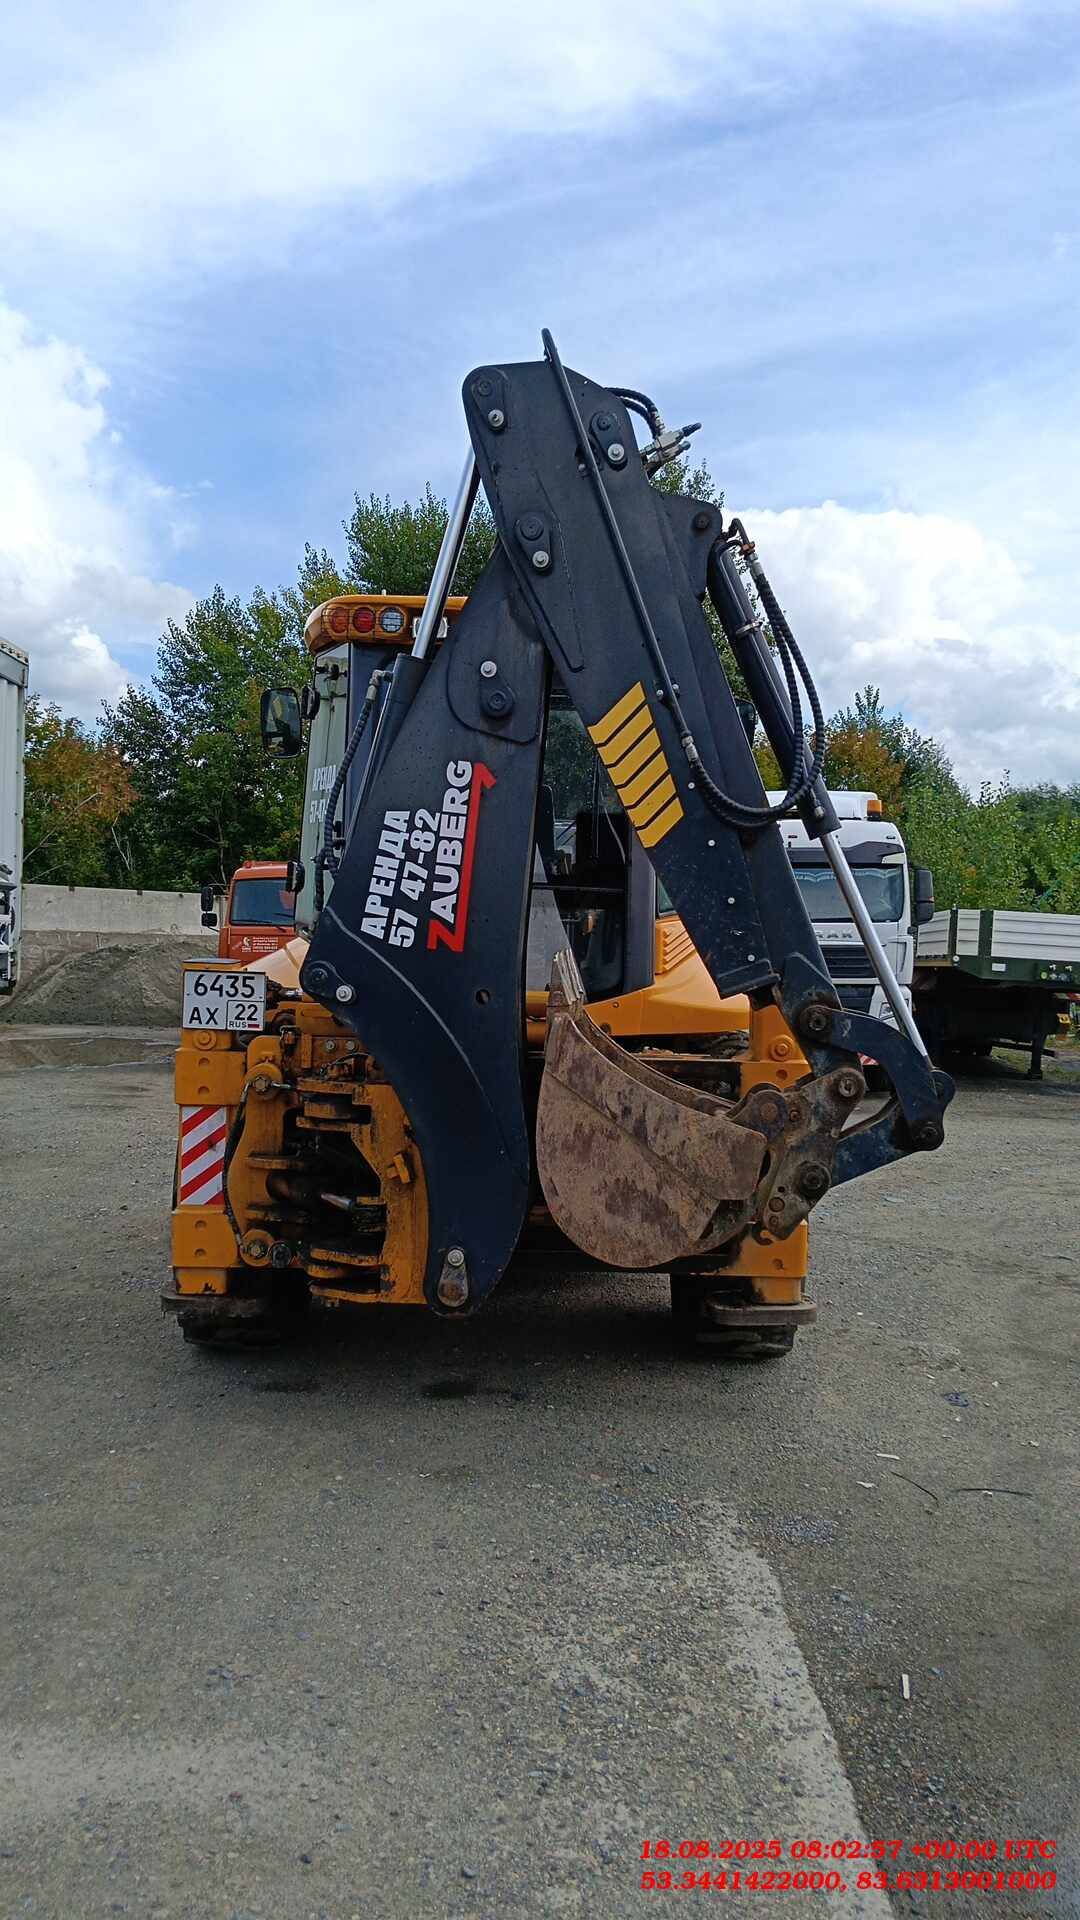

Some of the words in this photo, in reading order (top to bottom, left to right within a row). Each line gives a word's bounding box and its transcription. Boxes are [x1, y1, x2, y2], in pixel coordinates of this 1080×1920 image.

[400, 808, 441, 901] 47-82
[427, 760, 496, 952] ZAUBERG
[360, 810, 410, 940] АРЕНДА
[388, 908, 419, 948] 57
[193, 974, 255, 998] 6435
[228, 1020, 247, 1028] RUS
[234, 1003, 258, 1021] 22
